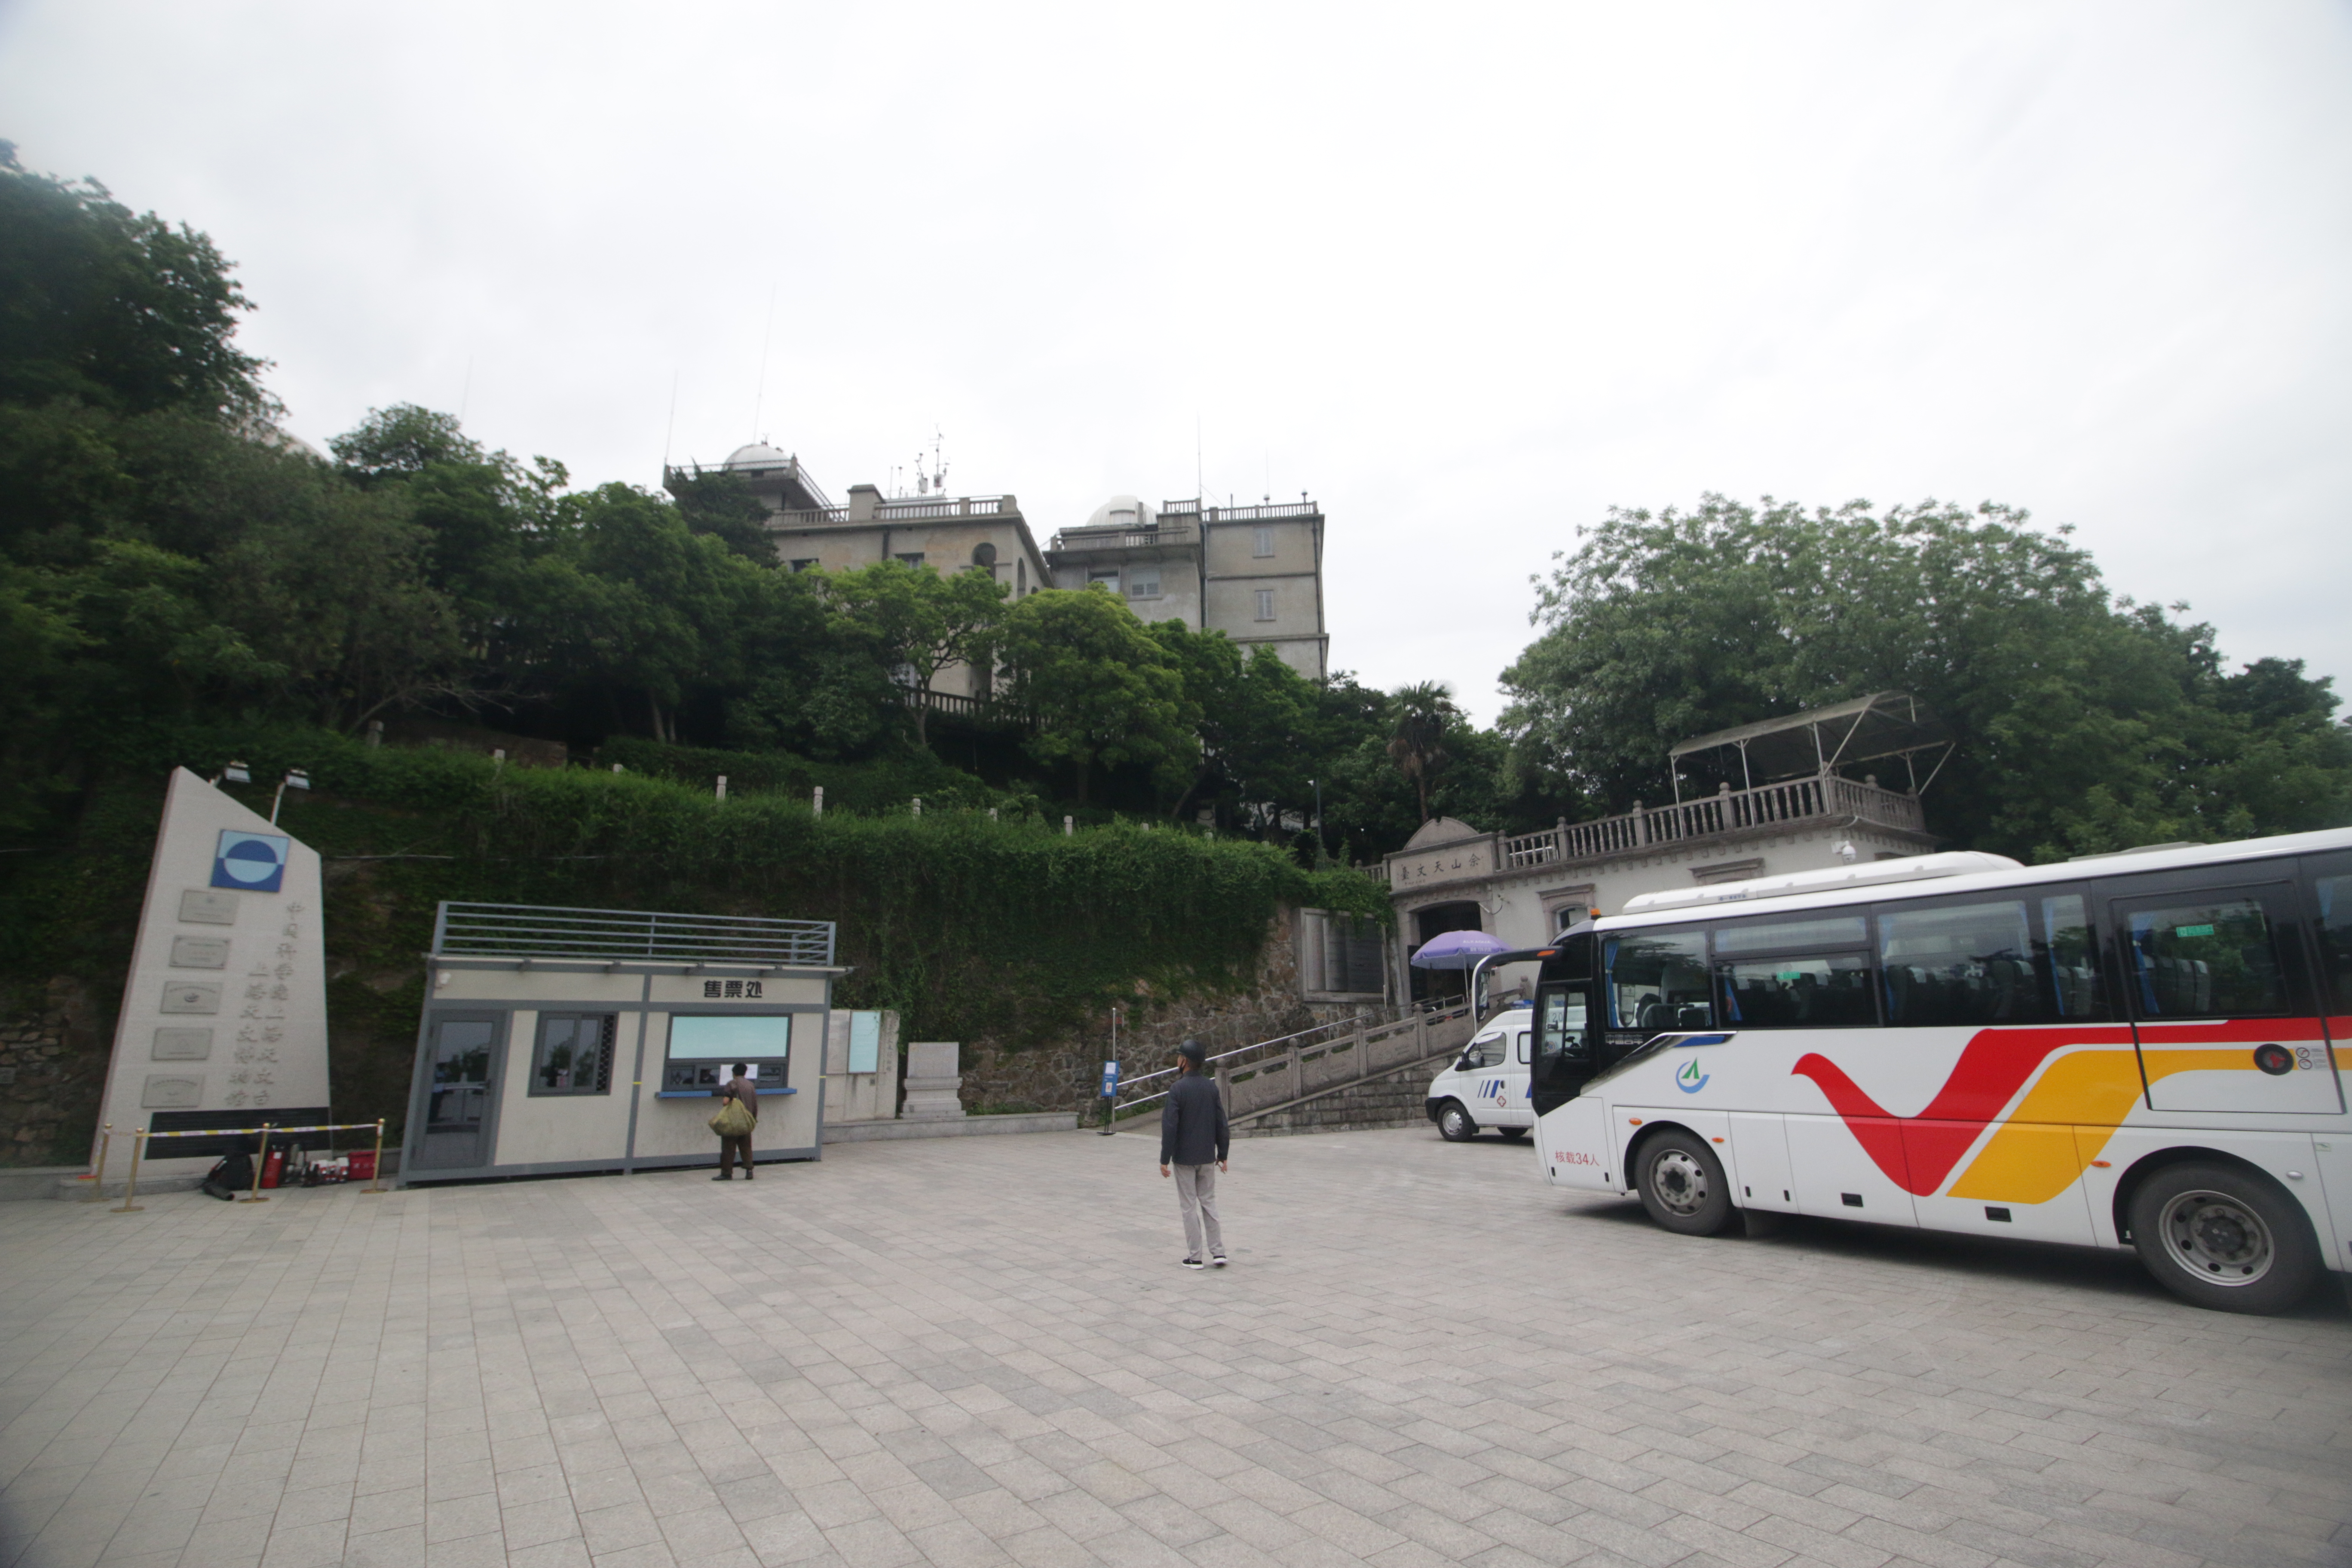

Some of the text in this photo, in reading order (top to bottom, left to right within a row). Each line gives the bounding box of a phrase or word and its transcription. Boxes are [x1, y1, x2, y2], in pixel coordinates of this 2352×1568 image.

[704, 980, 763, 998] 售票处
[1555, 1150, 1600, 1166] 核载34人
